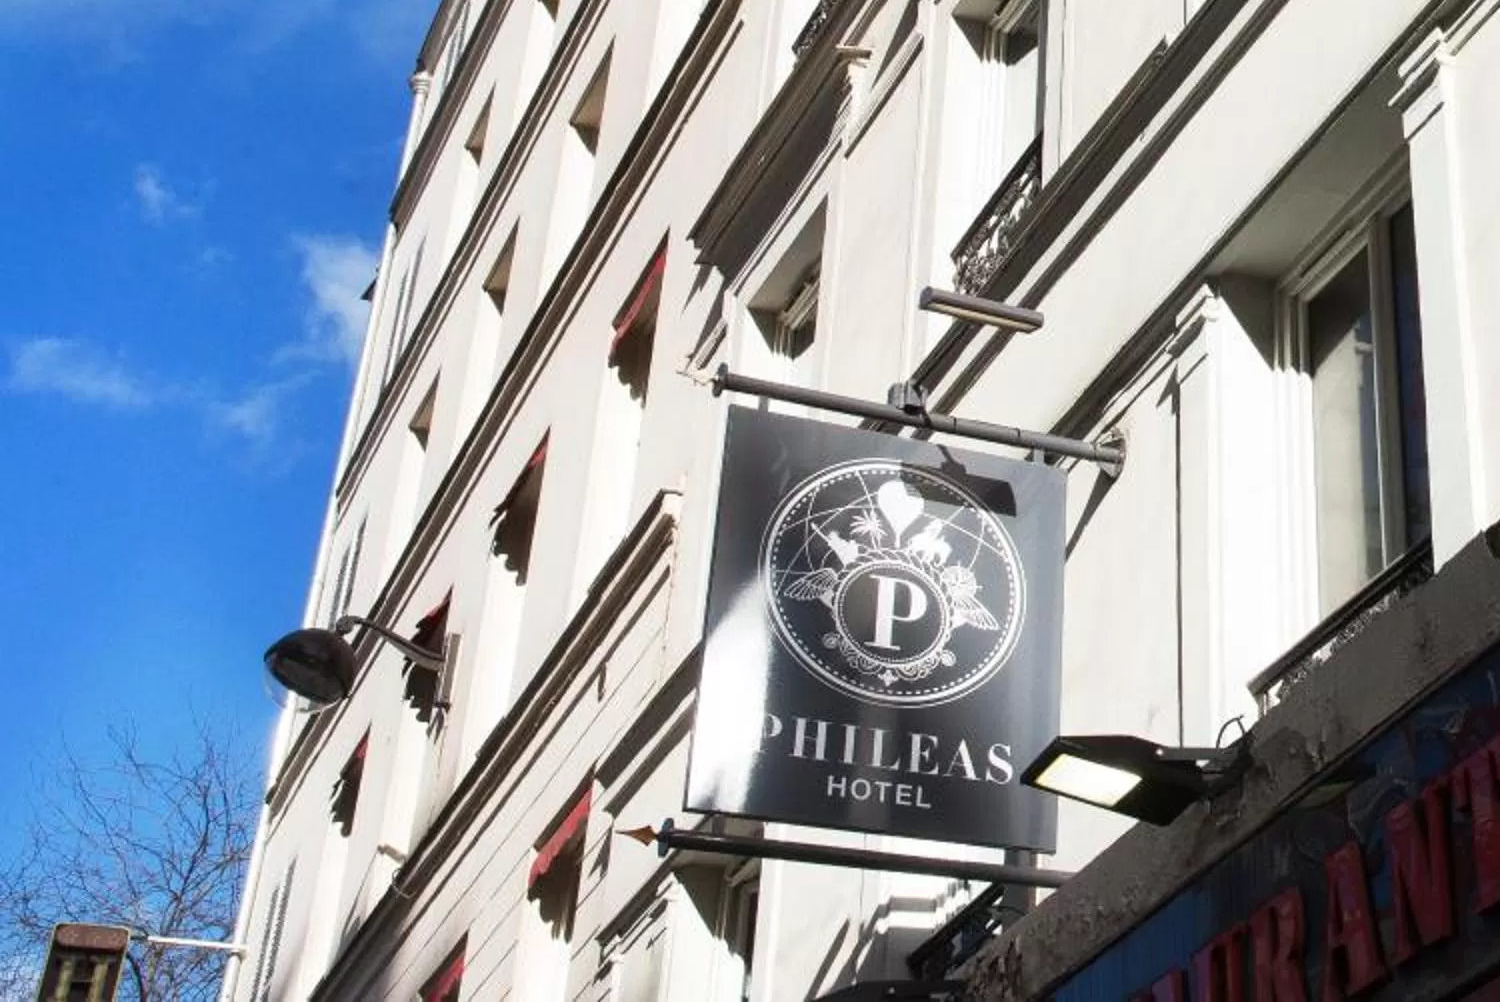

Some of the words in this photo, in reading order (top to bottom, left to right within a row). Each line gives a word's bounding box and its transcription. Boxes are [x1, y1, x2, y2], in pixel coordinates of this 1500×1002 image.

[864, 574, 928, 651] P
[755, 713, 1015, 785] PHILEAS
[827, 774, 933, 810] HOTEL
